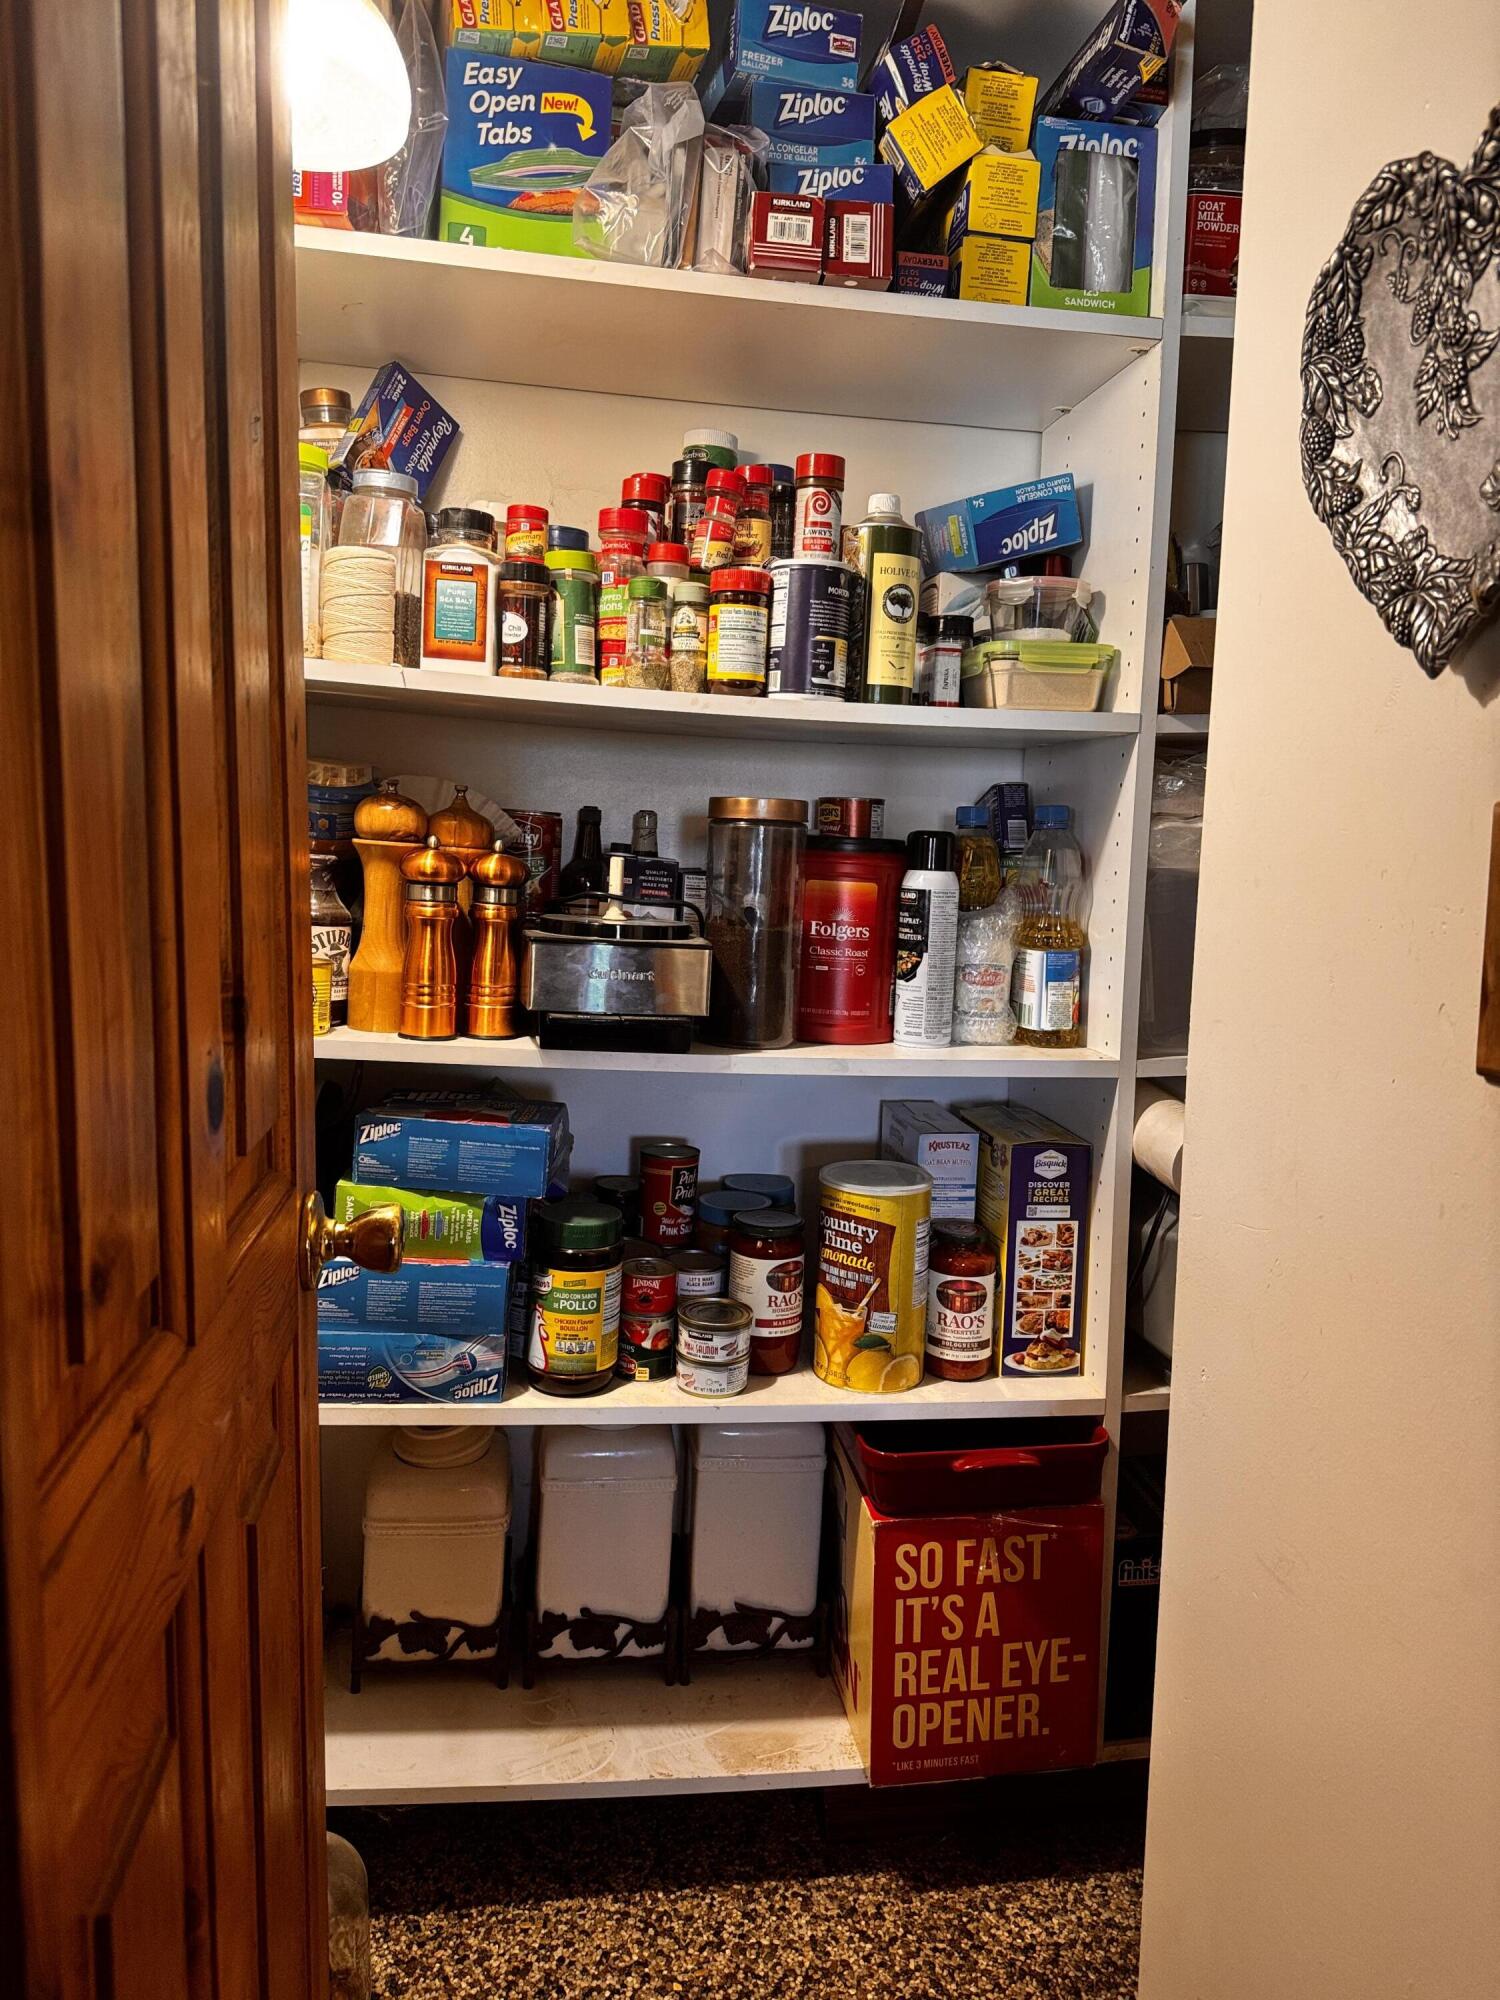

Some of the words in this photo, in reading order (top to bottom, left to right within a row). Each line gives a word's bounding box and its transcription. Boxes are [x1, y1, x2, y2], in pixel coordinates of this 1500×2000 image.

[460, 0, 476, 26] GLA
[548, 0, 564, 30] GLA
[568, 0, 579, 28] Pres
[651, 0, 661, 41] Press'
[767, 5, 834, 37] Ziploc
[630, 3, 647, 43] GLAD
[910, 36, 928, 60] 250
[929, 30, 955, 82] EVERYDAY
[741, 50, 783, 66] FREEZER
[741, 60, 769, 71] GALLON
[463, 61, 524, 89] Easy
[900, 44, 924, 93] Reynolds
[917, 63, 933, 92] Wrap
[468, 90, 536, 119] Open
[543, 95, 579, 112] New!
[778, 92, 846, 124] Ziploc
[477, 122, 533, 145] Tabs
[769, 151, 781, 160] RTO
[784, 153, 793, 161] DE
[777, 144, 818, 154] CONGELAR
[797, 167, 864, 198] Ziploc
[332, 191, 343, 206] 10
[773, 198, 811, 209] KIRKLAND
[1198, 200, 1226, 211] GOAT
[1198, 211, 1224, 221] MILK
[1197, 222, 1240, 234] POWDER
[903, 255, 944, 267] EVERYDAY
[900, 277, 920, 287] 250
[920, 280, 946, 293] Wrap
[1065, 297, 1115, 309] SANDWICH
[396, 374, 408, 386] 2
[412, 400, 431, 425] Oven
[402, 424, 419, 447] Bags
[404, 430, 432, 475] KITCHENS
[417, 416, 453, 473] Reynolds
[1046, 477, 1070, 488] CUARTO
[1055, 483, 1072, 494] PARA
[972, 498, 985, 509] 54
[1016, 488, 1053, 503] CONGELAR
[803, 528, 833, 537] LAWRY'S
[1002, 513, 1058, 555] Ziploc
[441, 564, 473, 573] KIRKLAND
[439, 596, 456, 604] SEA
[457, 597, 473, 606] SALT
[446, 589, 467, 597] PURE
[599, 602, 623, 611] nions
[820, 806, 839, 817] USH'S
[900, 891, 917, 900] LAND
[810, 920, 870, 941] Folgers
[311, 928, 351, 954] STUBB
[809, 946, 843, 957] Classic
[844, 947, 868, 958] Roast
[359, 1122, 402, 1145] Ziploc
[928, 1140, 970, 1152] KRUSTEAZ
[1034, 1158, 1068, 1169] Bisquick
[674, 1188, 696, 1200] Prid
[1034, 1188, 1070, 1196] GREAT
[346, 1195, 354, 1222] SAND
[498, 1204, 517, 1249] Ziploc
[659, 1225, 678, 1236] PINK
[819, 1209, 879, 1244] Country
[823, 1228, 863, 1254] Time
[820, 1247, 876, 1273] emonade
[317, 1265, 360, 1289] Ziploc
[632, 1278, 663, 1290] LINDSAY
[559, 1300, 597, 1311] POLLO
[936, 1311, 985, 1329] RAO'S
[695, 1345, 719, 1356] SALMON
[367, 1371, 388, 1383] SHIELD
[454, 1372, 499, 1400] Ziploc
[894, 1541, 943, 1591] SO
[1119, 1557, 1161, 1580] finis
[895, 1594, 964, 1645] IT'S
[975, 1592, 1000, 1638] A
[894, 1646, 990, 1697] REAL
[1001, 1637, 1087, 1687] EYE-
[892, 1693, 1050, 1749] OPENER.
[916, 1758, 922, 1768] 3
[923, 1756, 958, 1768] MINUTES
[959, 1754, 980, 1766] FAST
